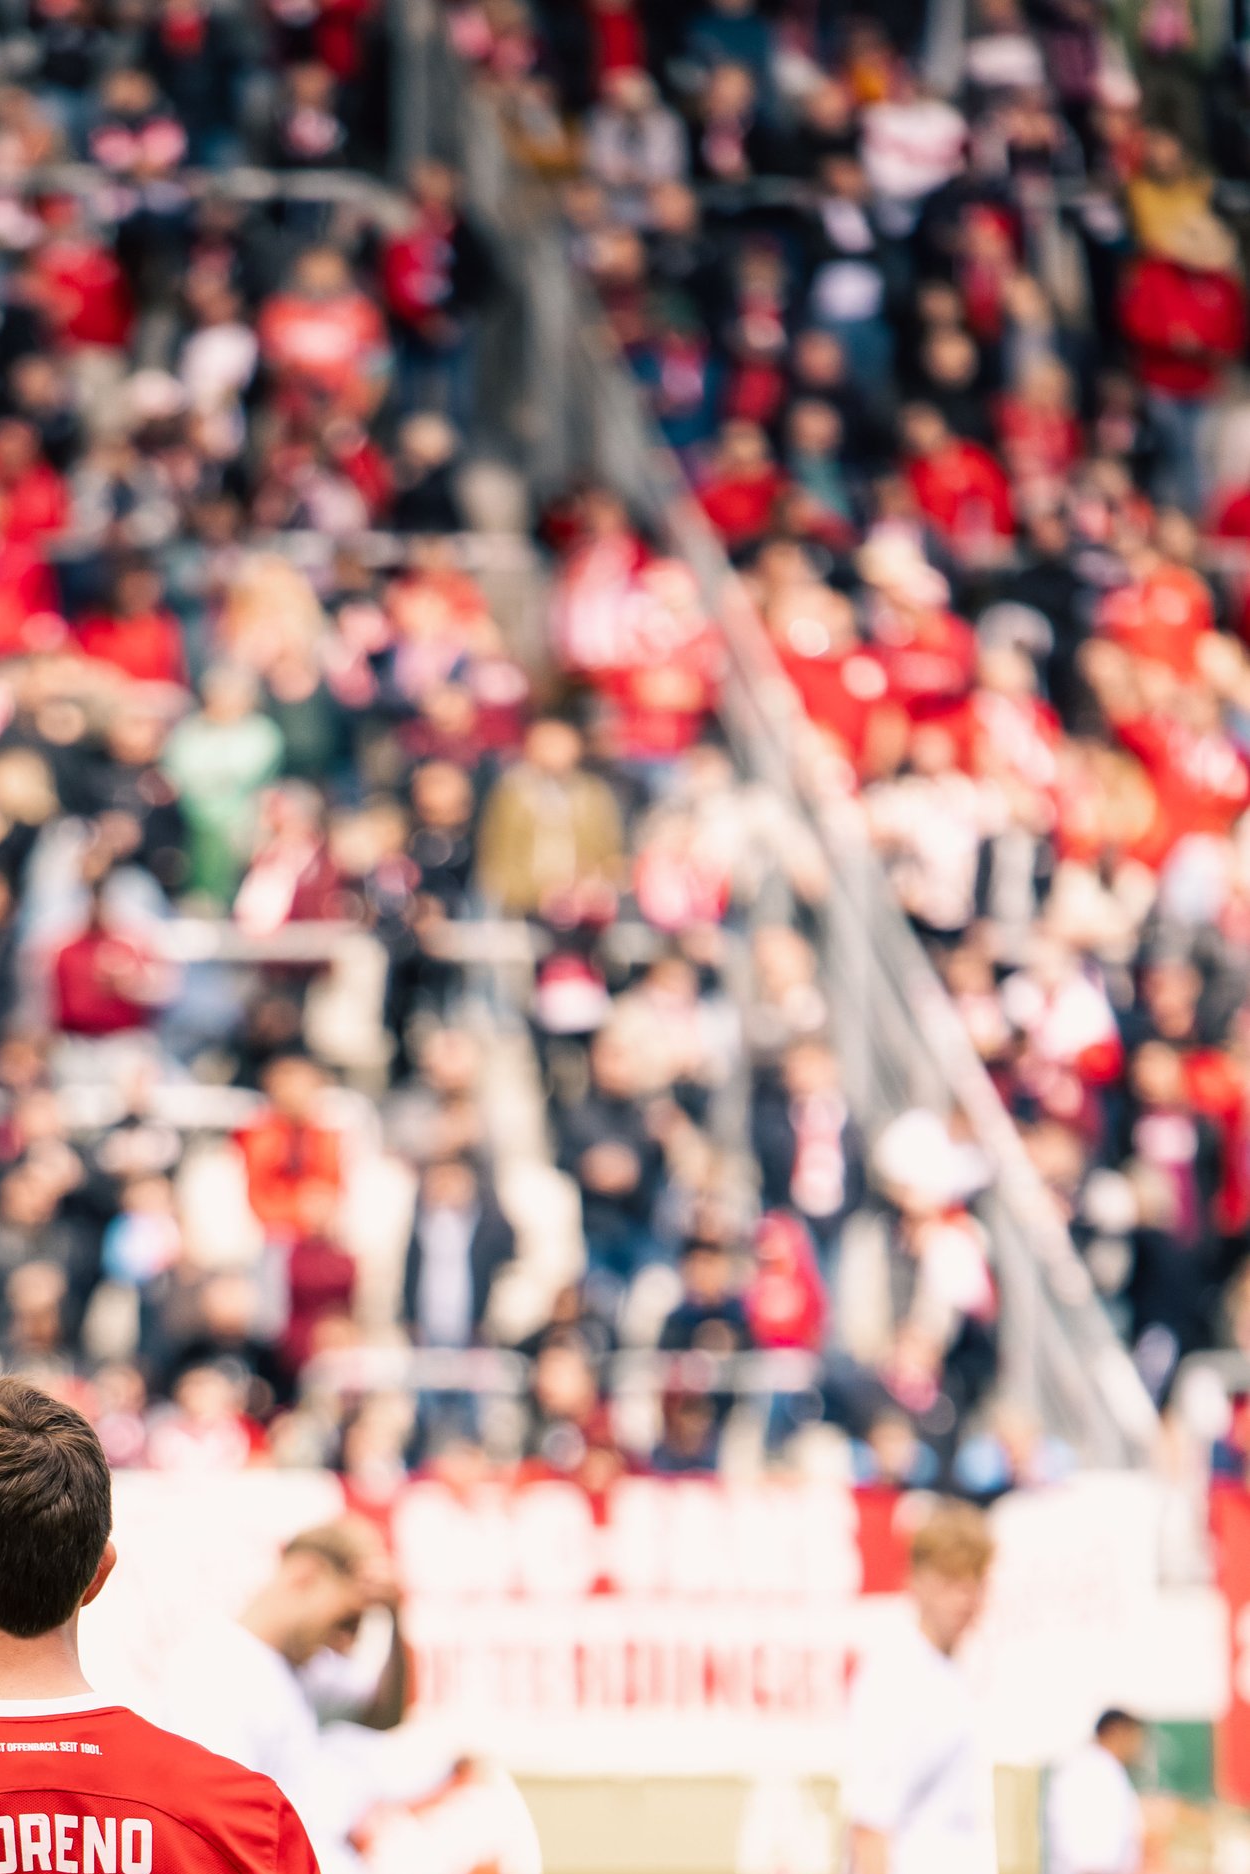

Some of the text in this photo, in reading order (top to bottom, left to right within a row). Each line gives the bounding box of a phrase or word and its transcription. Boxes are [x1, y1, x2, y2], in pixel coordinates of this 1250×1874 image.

[6, 1741, 59, 1752] OFFENBACH.
[59, 1741, 78, 1753] SEIT
[80, 1742, 103, 1756] 1901.
